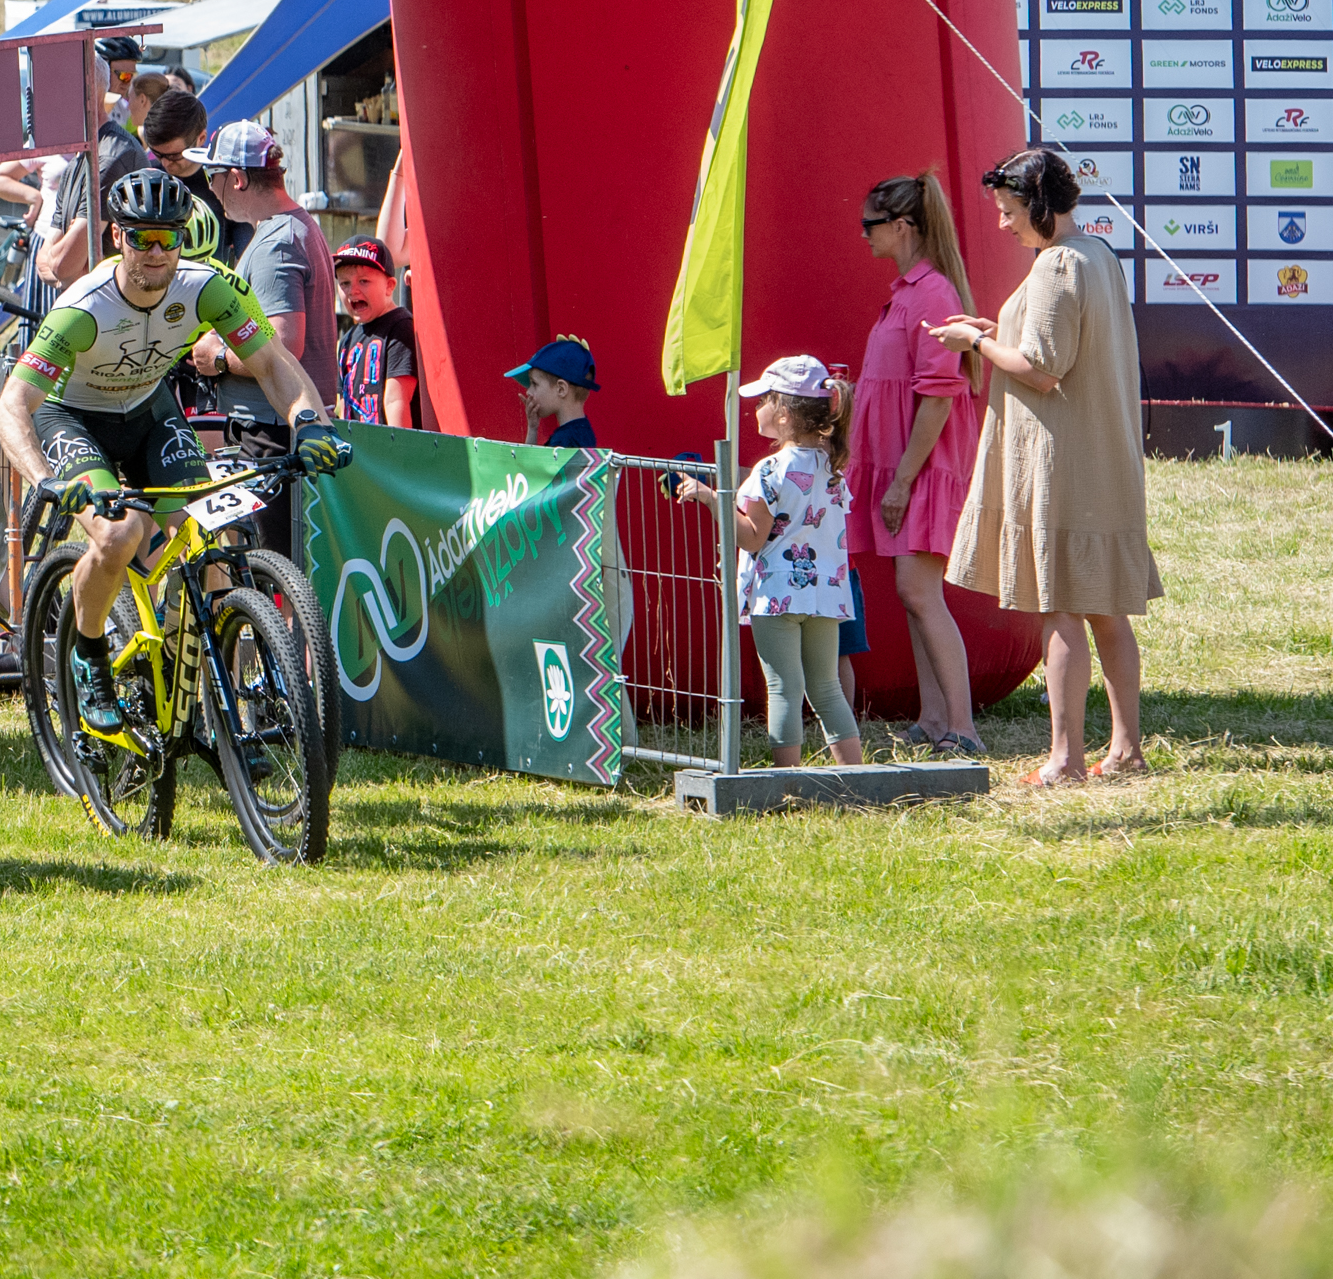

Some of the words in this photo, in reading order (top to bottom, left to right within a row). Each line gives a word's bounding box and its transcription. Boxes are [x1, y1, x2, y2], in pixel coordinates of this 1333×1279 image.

[1050, 0, 1119, 11] VELOEXPRESS
[1190, 7, 1218, 15] FONDS
[1149, 60, 1179, 68] GREEN
[1189, 60, 1226, 68] MOTORS
[1255, 59, 1324, 70] VELOEXPRESS
[1089, 113, 1105, 121] LRJ
[1089, 121, 1118, 129] FONDS
[1178, 156, 1201, 174] SN
[1183, 220, 1219, 235] VIRŠI
[54, 333, 72, 347] Eko
[48, 339, 73, 358] STEEL
[20, 352, 57, 378] SFM
[90, 367, 126, 379] RIGA
[205, 492, 243, 516] 43
